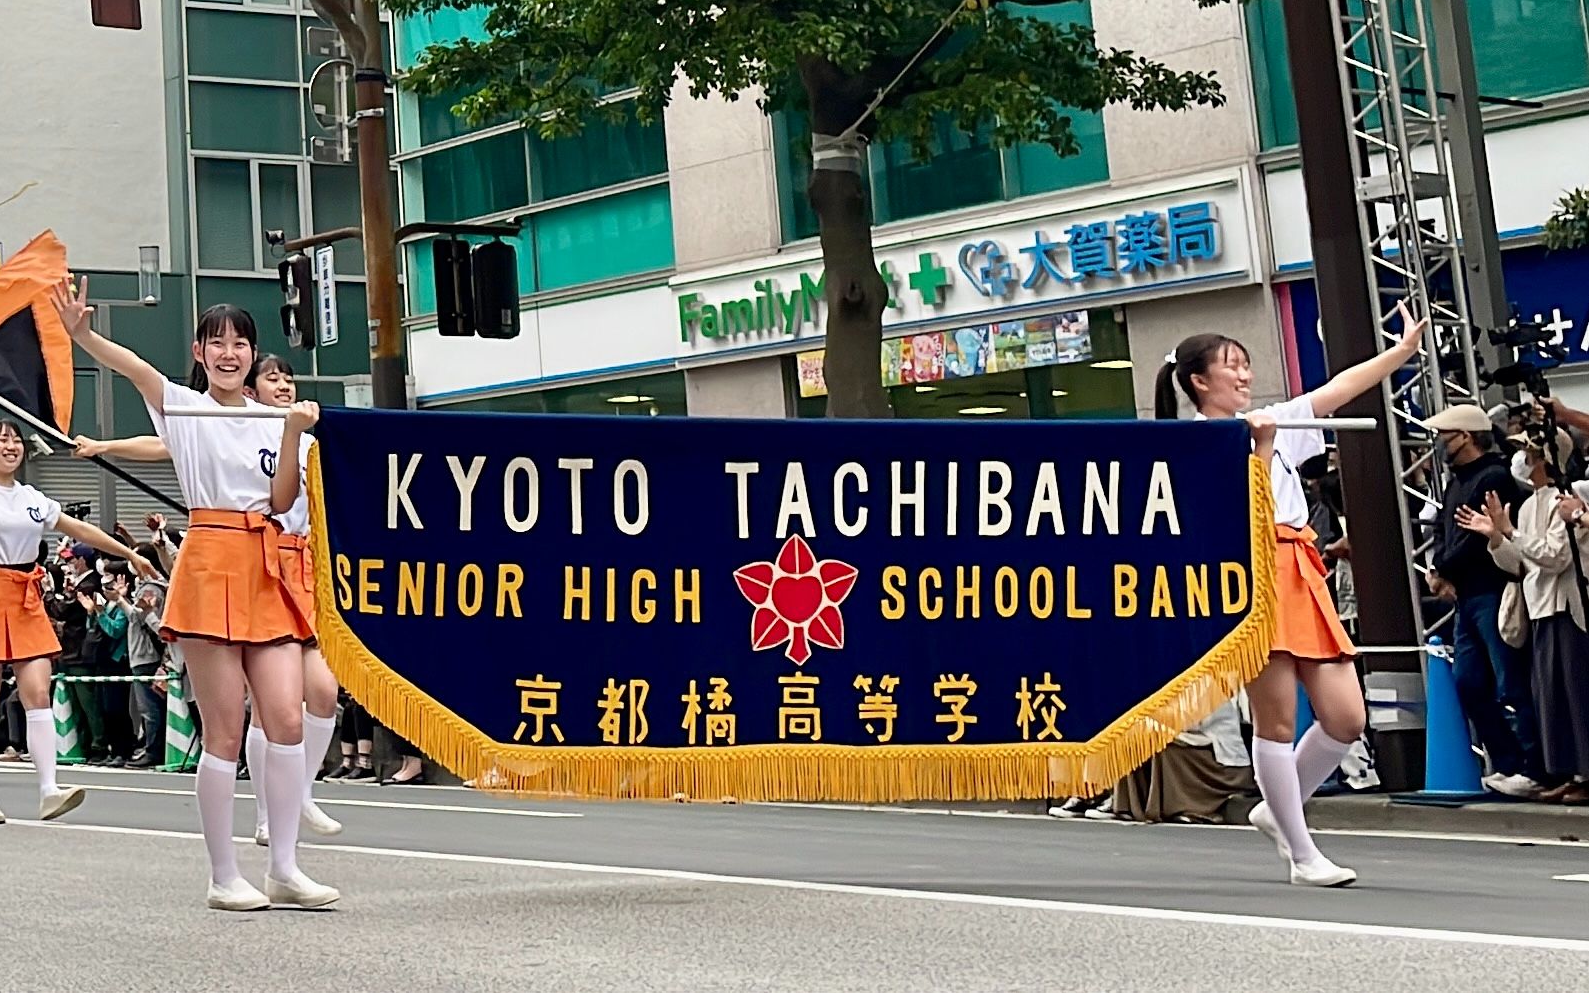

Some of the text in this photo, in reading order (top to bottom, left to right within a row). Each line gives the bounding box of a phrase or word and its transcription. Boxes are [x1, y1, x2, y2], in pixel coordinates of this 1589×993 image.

[1020, 201, 1217, 290] 大賀薬局
[387, 453, 1181, 539] KYOTO TACHIBANA
[336, 553, 1248, 624] SENIOR HIGH SCHOOL BAND
[512, 671, 1066, 746] 京都橘高等学校
